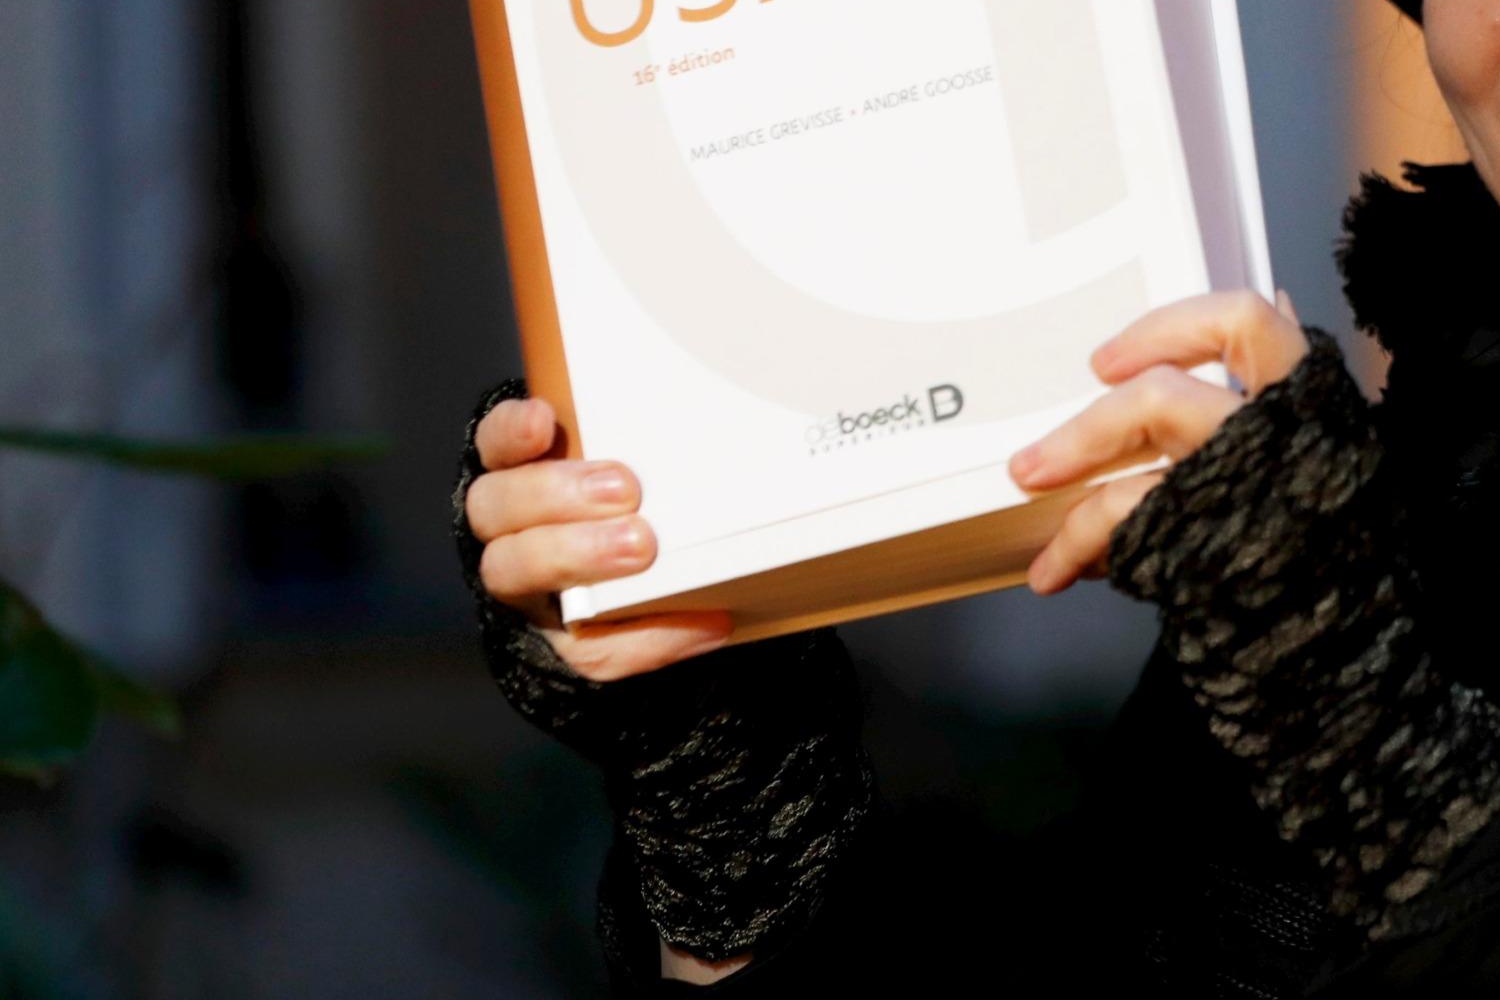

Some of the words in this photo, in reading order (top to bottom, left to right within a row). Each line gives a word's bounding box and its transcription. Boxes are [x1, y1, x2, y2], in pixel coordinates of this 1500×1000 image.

[668, 48, 735, 76] édition
[690, 128, 766, 161] MAURICE
[770, 106, 843, 141] GREVISSE
[925, 65, 994, 98] GOOSSE
